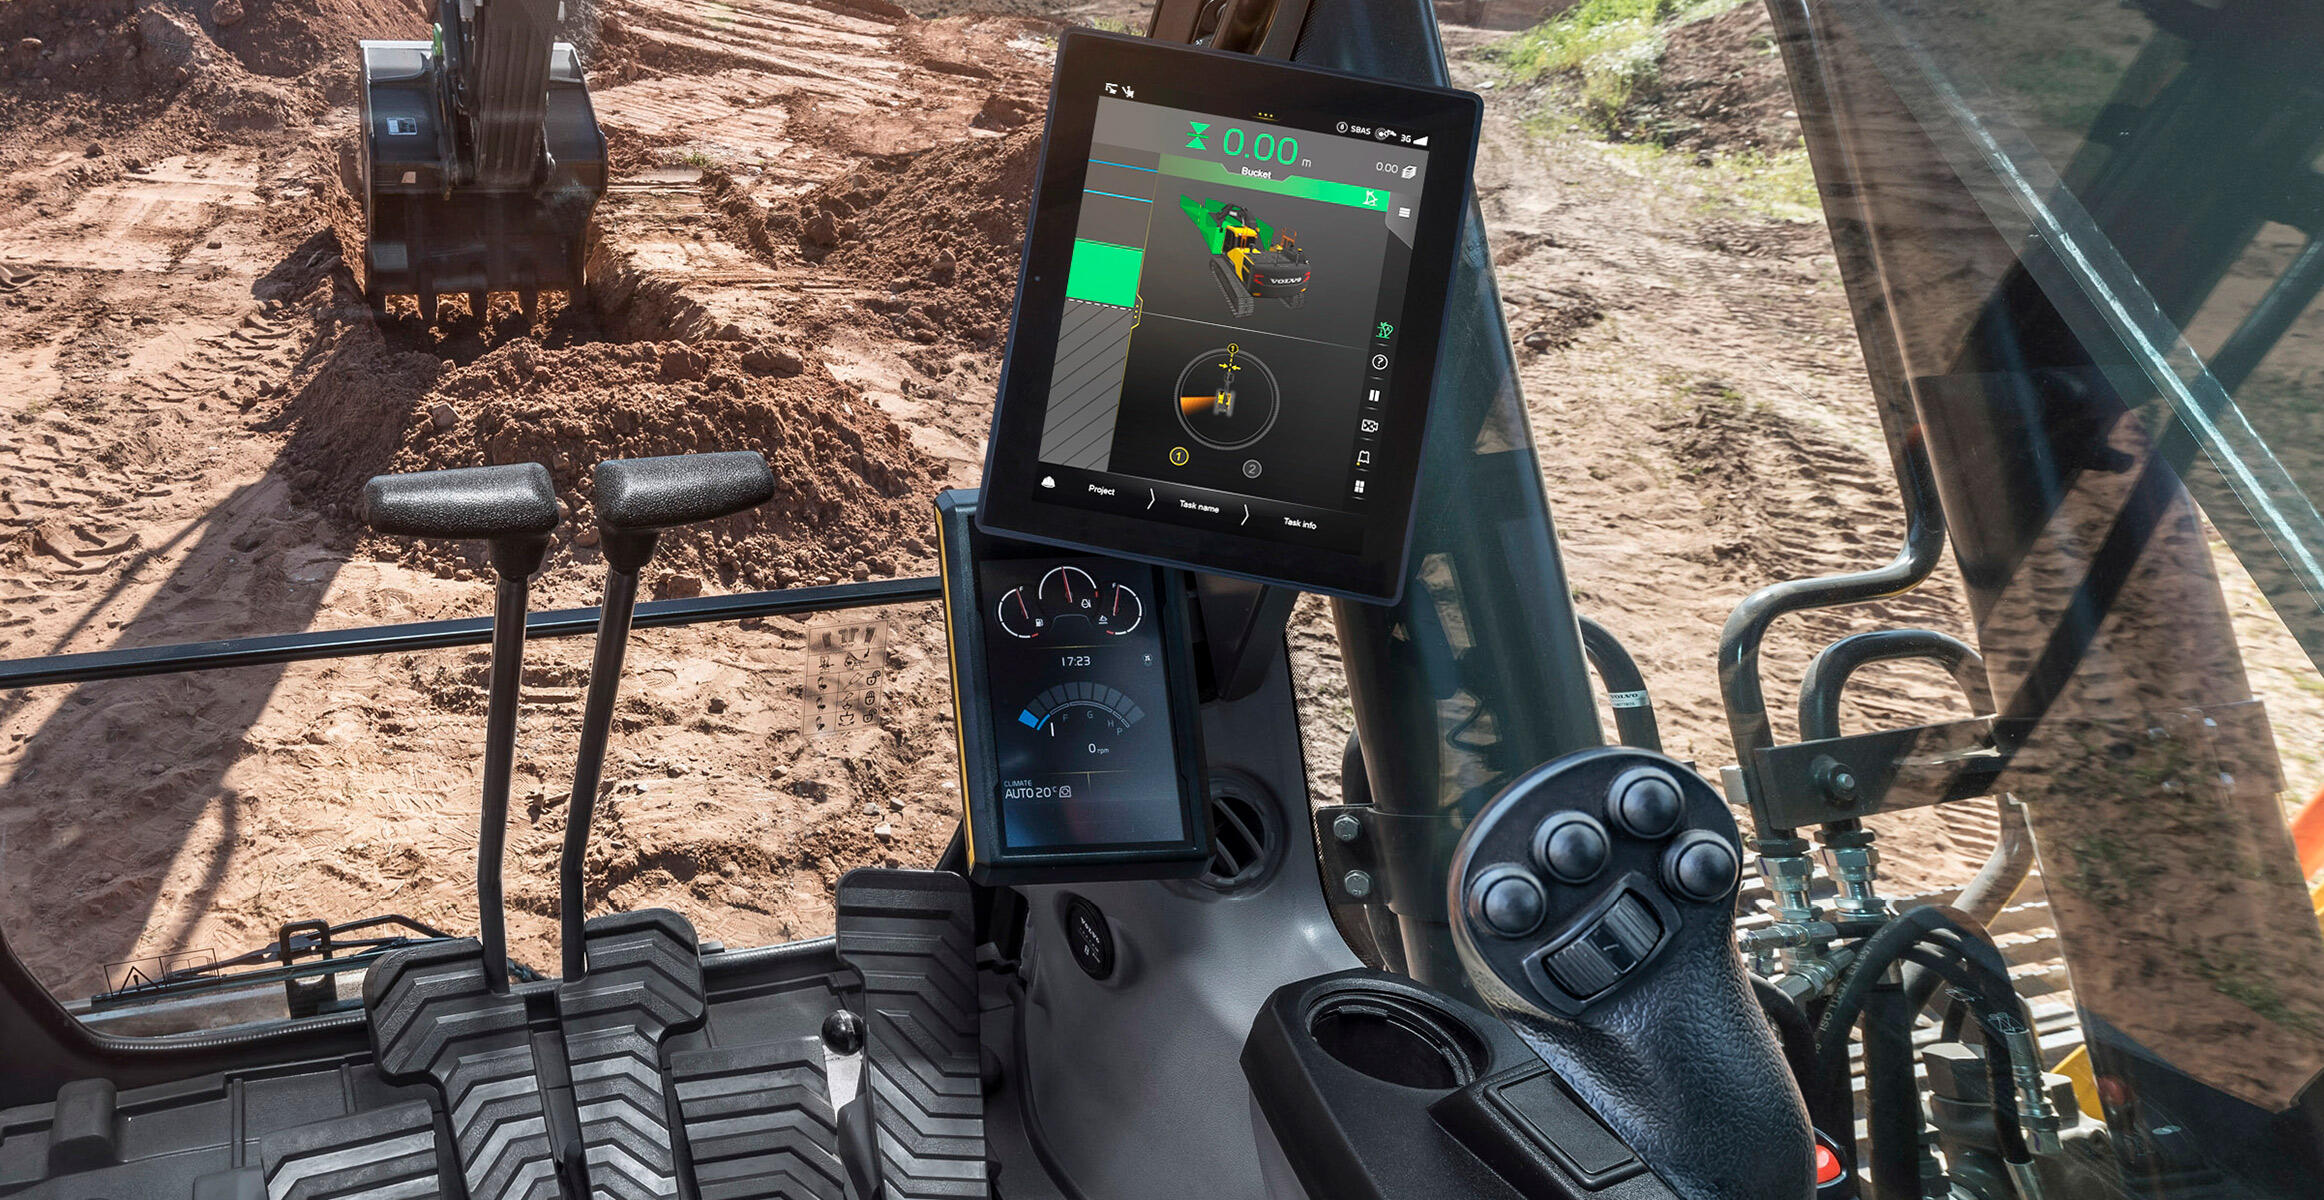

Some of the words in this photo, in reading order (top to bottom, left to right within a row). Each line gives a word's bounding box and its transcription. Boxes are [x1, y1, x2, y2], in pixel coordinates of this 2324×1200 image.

[1350, 125, 1371, 135] SBAS
[1223, 128, 1298, 165] 0.00
[1301, 158, 1312, 167] m
[1241, 166, 1272, 179] Bucket
[1375, 161, 1399, 174] 0.00
[1088, 484, 1115, 496] Project
[1180, 499, 1197, 510] Task
[1198, 504, 1220, 513] name
[1284, 516, 1301, 527] Task
[1302, 520, 1317, 530] info
[1061, 656, 1091, 667] 17:23
[1086, 710, 1093, 719] G
[1116, 727, 1123, 736] P
[1088, 743, 1097, 753] 0
[1005, 787, 1034, 799] AUTO
[1818, 1011, 1833, 1032] ISO
